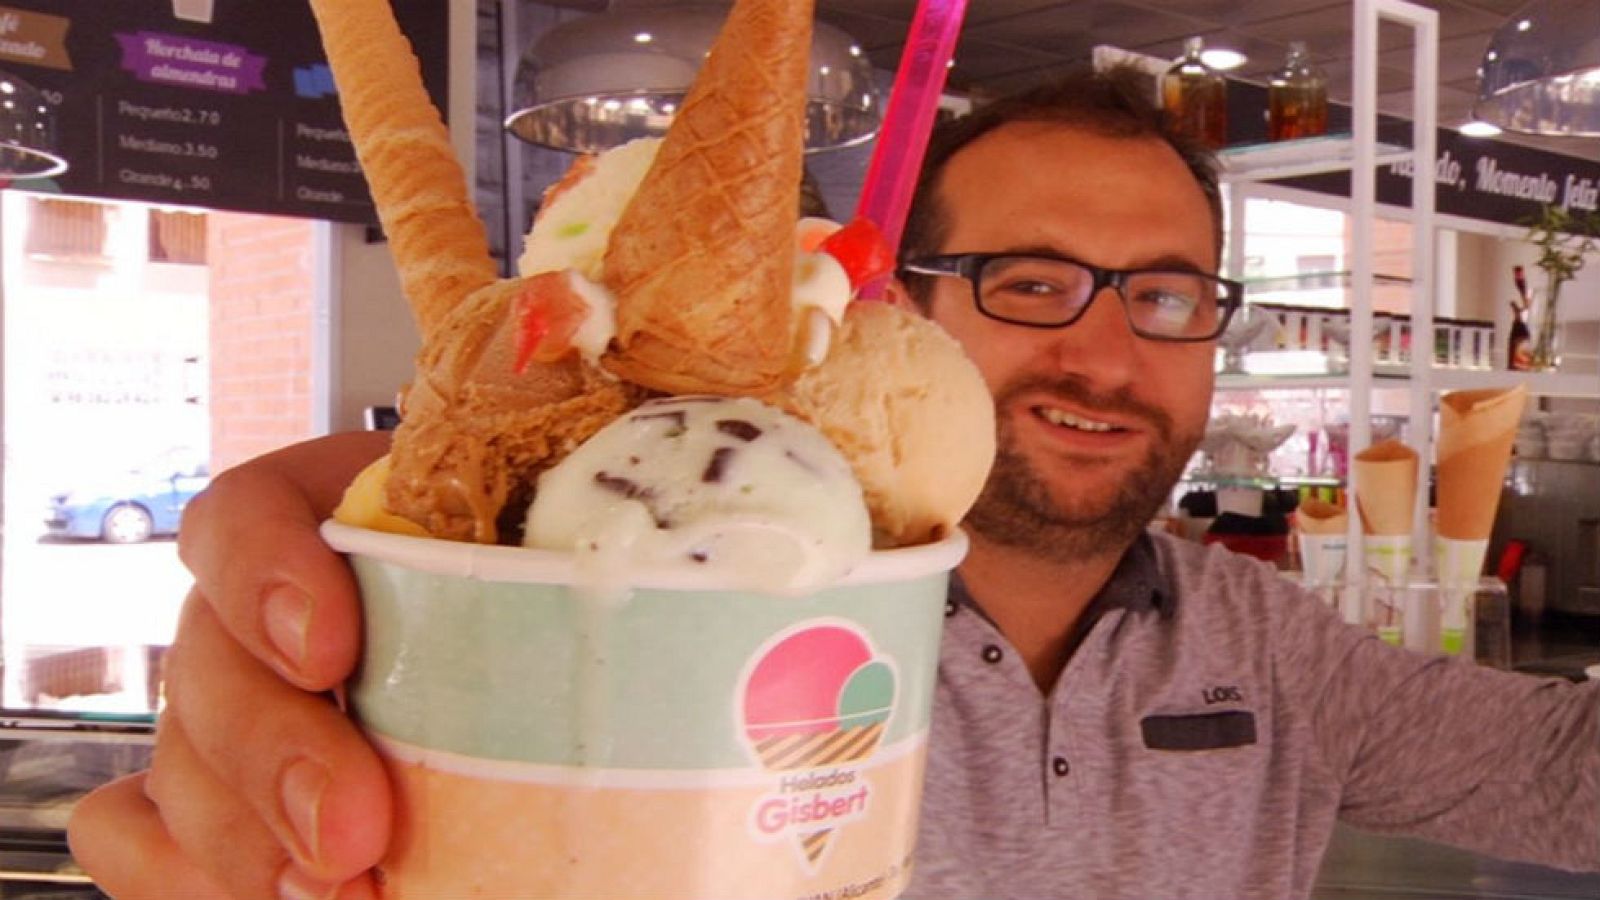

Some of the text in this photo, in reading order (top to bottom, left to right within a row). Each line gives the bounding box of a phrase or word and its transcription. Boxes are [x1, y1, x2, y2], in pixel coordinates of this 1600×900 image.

[221, 52, 242, 68] de
[1475, 156, 1558, 203] Momento
[1202, 686, 1243, 705] LOIS
[779, 769, 857, 793] Helados
[756, 786, 868, 834] Gisbert
